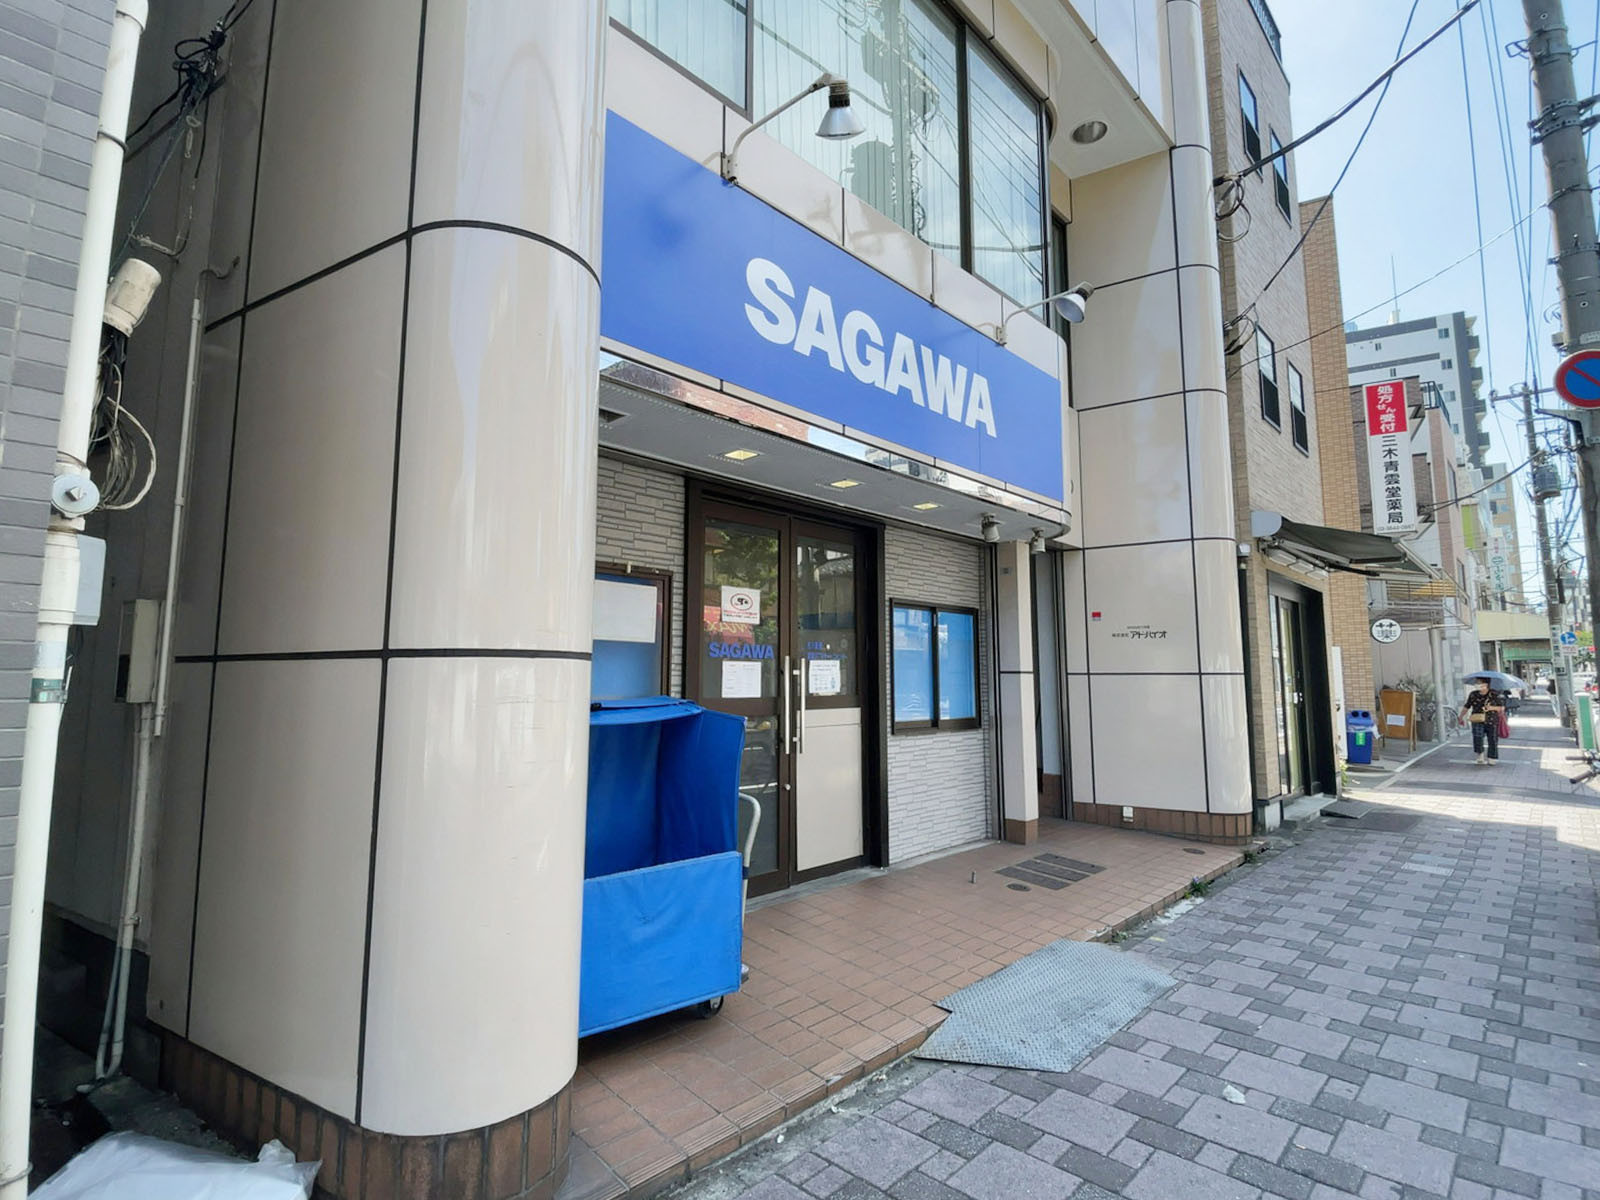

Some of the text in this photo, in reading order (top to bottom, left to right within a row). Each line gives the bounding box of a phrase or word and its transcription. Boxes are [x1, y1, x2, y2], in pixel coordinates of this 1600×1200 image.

[744, 257, 997, 438] SAGAWA
[1376, 385, 1396, 432] 処方せん受付
[1382, 434, 1403, 524] 三木青雲堂薬局
[709, 642, 775, 659] SAGAWA
